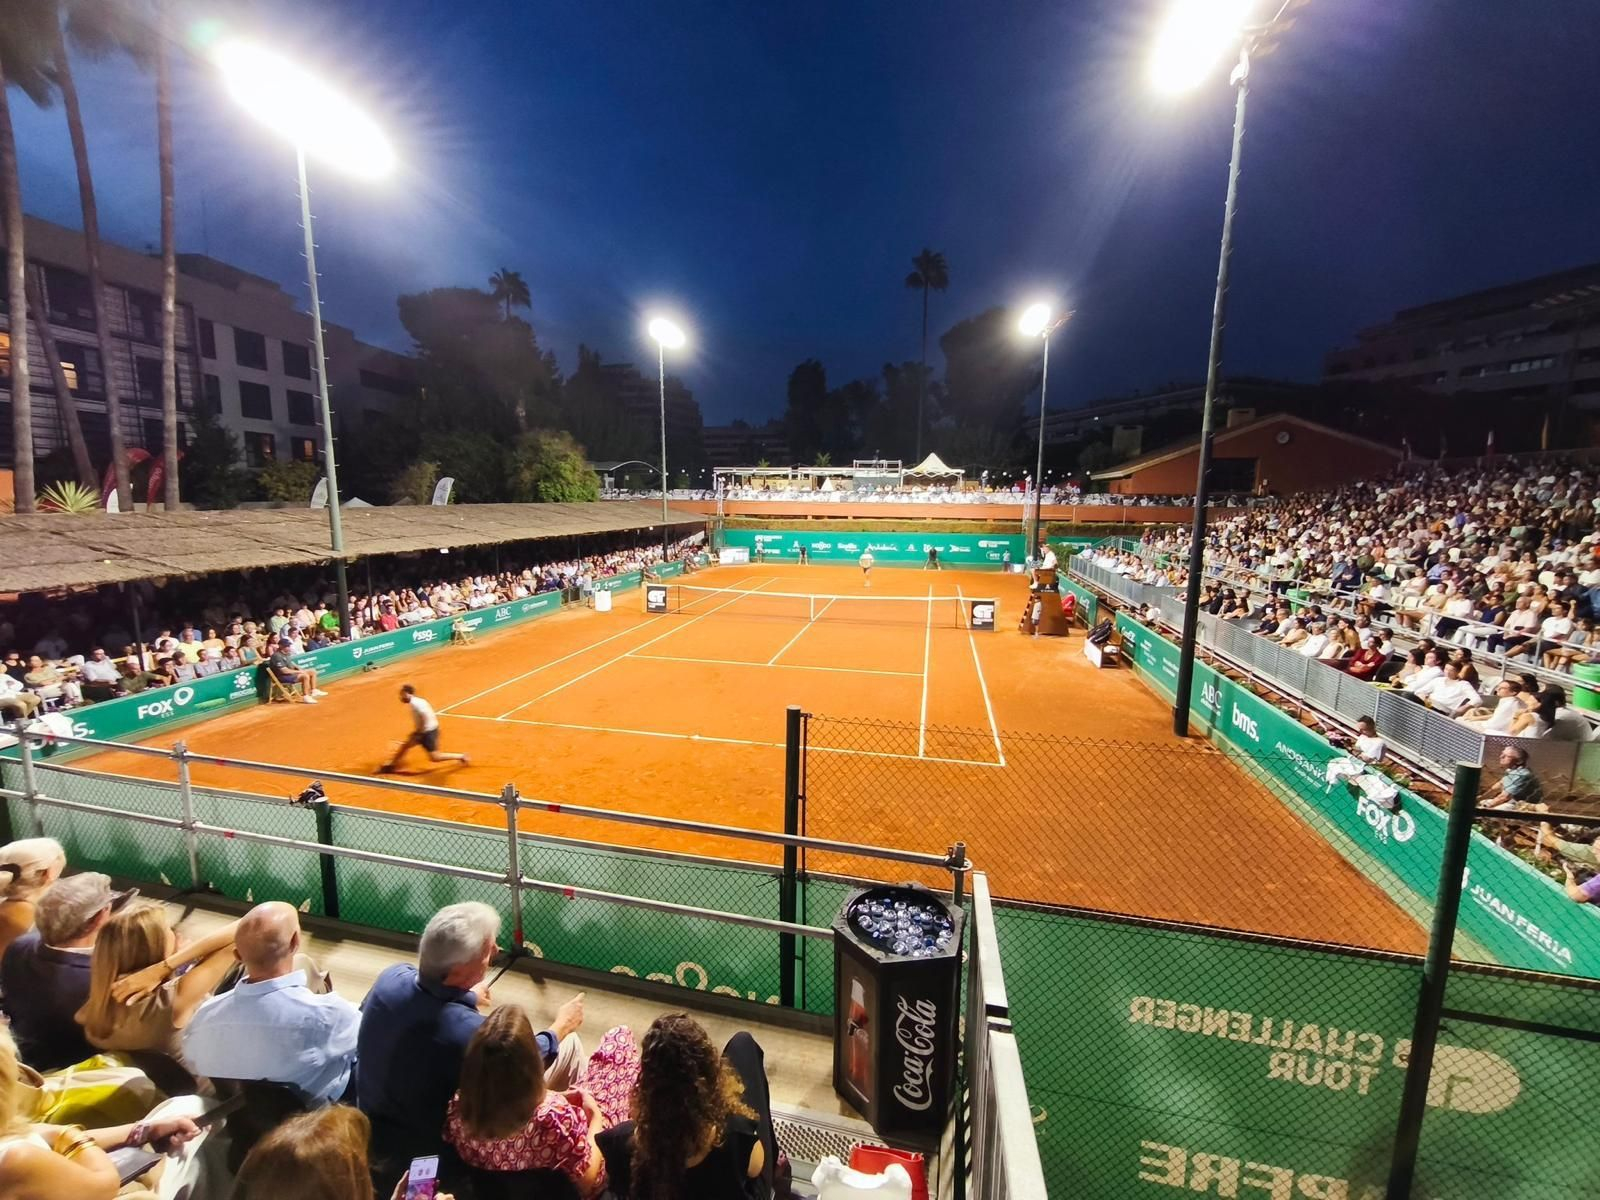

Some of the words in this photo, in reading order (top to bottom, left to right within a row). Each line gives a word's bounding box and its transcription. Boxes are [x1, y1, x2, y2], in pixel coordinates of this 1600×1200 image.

[495, 606, 512, 619] ABC
[1200, 681, 1223, 708] ABC
[1232, 702, 1260, 743] bms.
